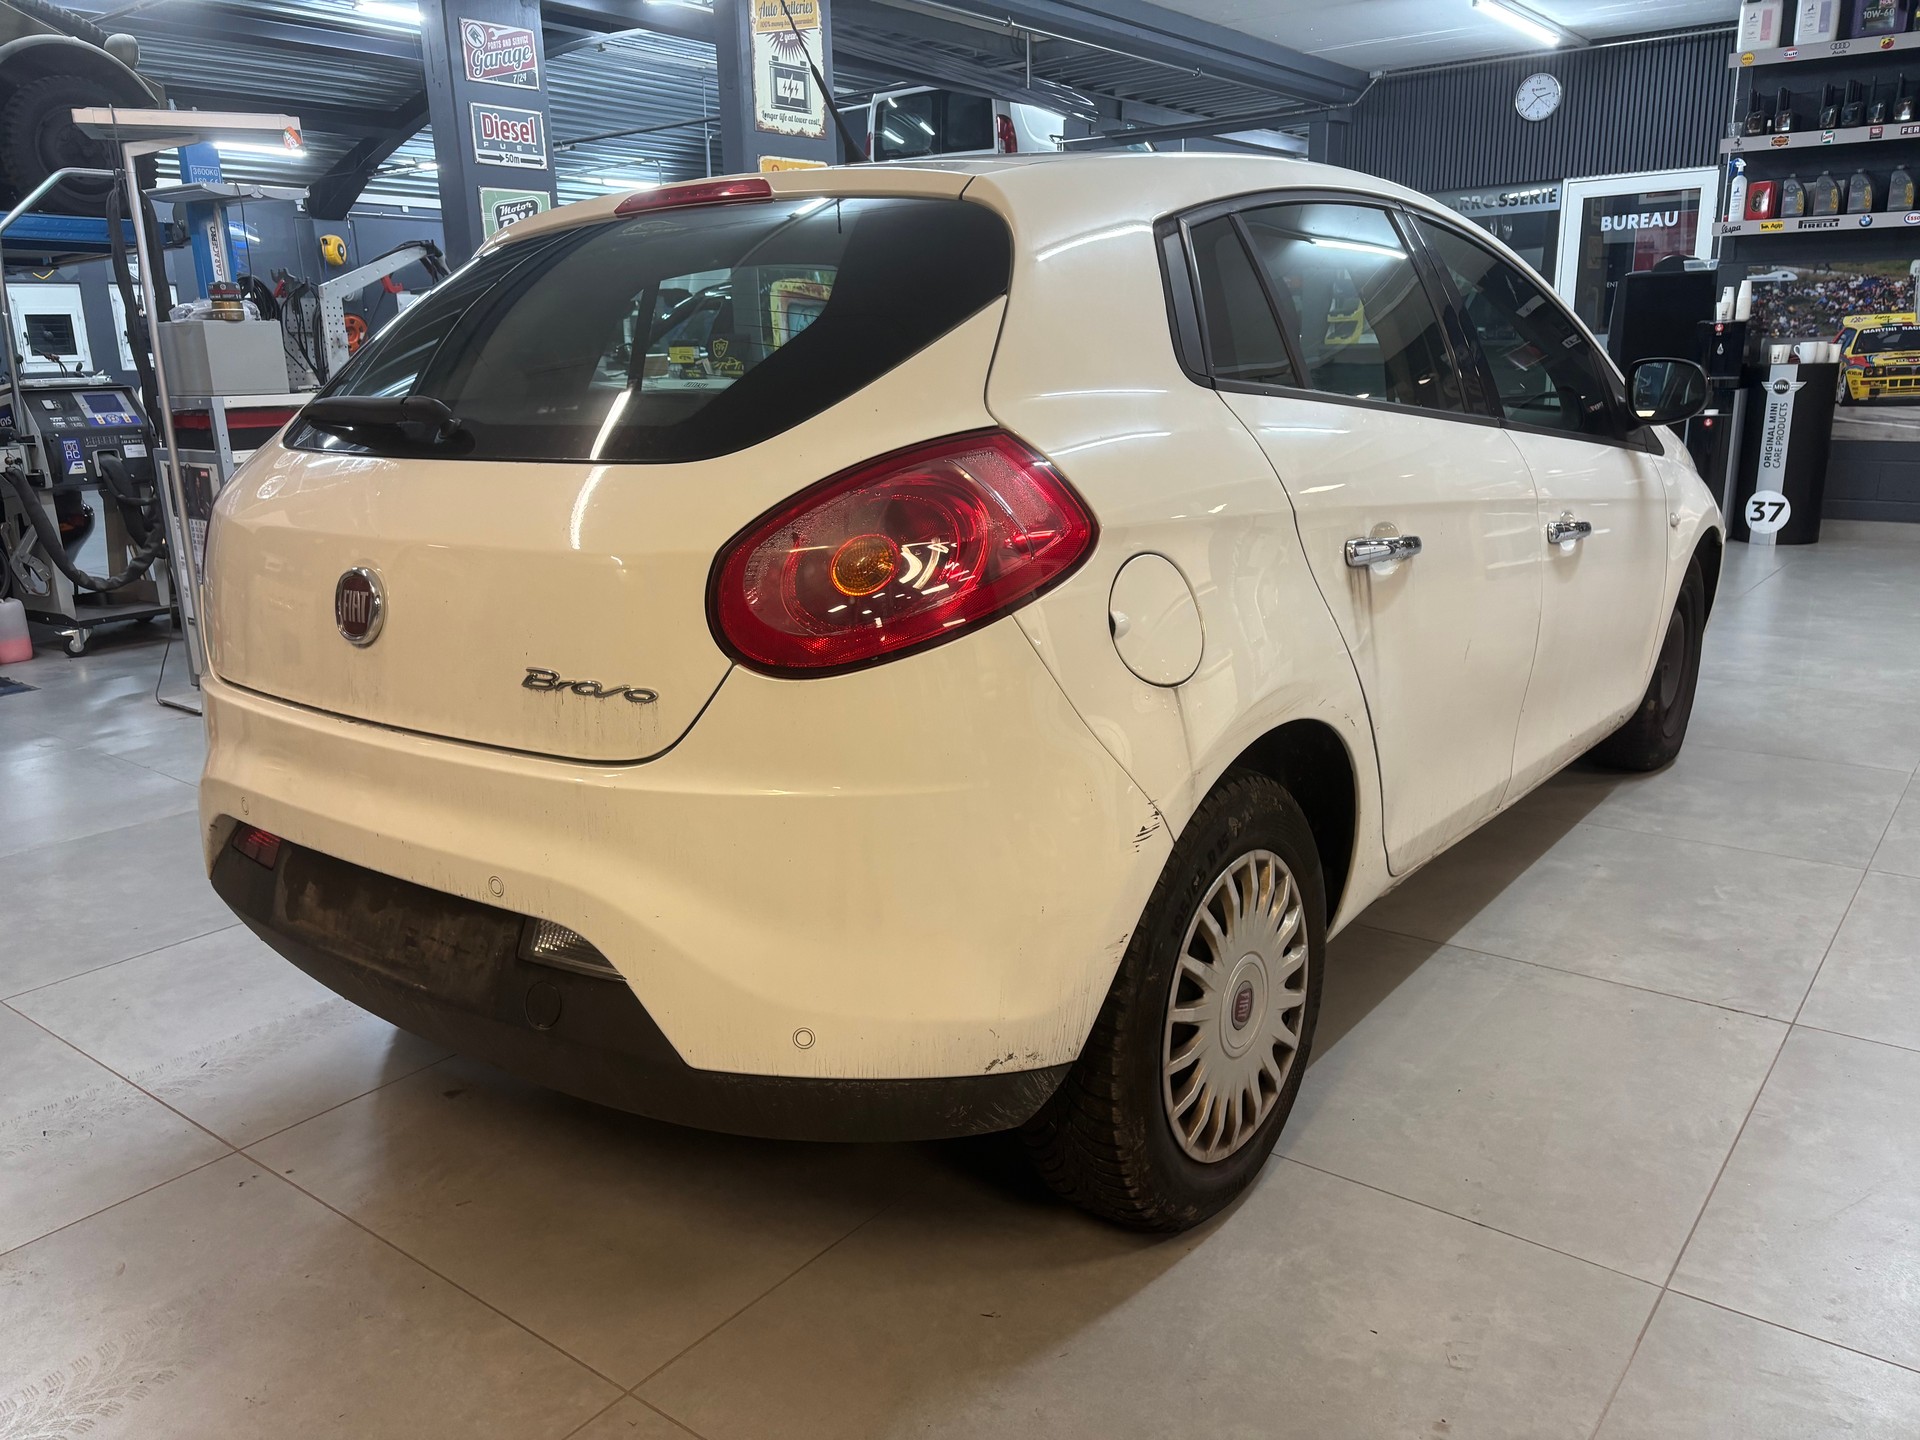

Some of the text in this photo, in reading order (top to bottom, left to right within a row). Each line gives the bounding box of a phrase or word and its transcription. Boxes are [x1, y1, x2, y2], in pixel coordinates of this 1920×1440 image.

[759, 1, 777, 19] Auto
[1863, 8, 1895, 19] 10W-60
[487, 35, 529, 50] PARTS AND SERVICE
[779, 32, 784, 41] 2
[471, 45, 533, 77] Garage
[794, 115, 807, 124] lower
[480, 111, 537, 145] Diesel
[484, 141, 538, 153] FUEL
[505, 155, 520, 164] 50m
[1448, 188, 1557, 212] ARROSSERIE
[500, 201, 533, 216] Motor
[1600, 210, 1679, 232] BUREAU
[1798, 219, 1840, 229] PIRELLI
[1721, 225, 1741, 235] Vespa
[1863, 326, 1897, 334] MARTINI
[1763, 402, 1779, 468] ORIGINAL MINI
[1772, 402, 1789, 469] CARE PRODUCTS
[1750, 501, 1786, 522] 37
[342, 589, 369, 623] FIAT
[521, 666, 659, 703] Bravo
